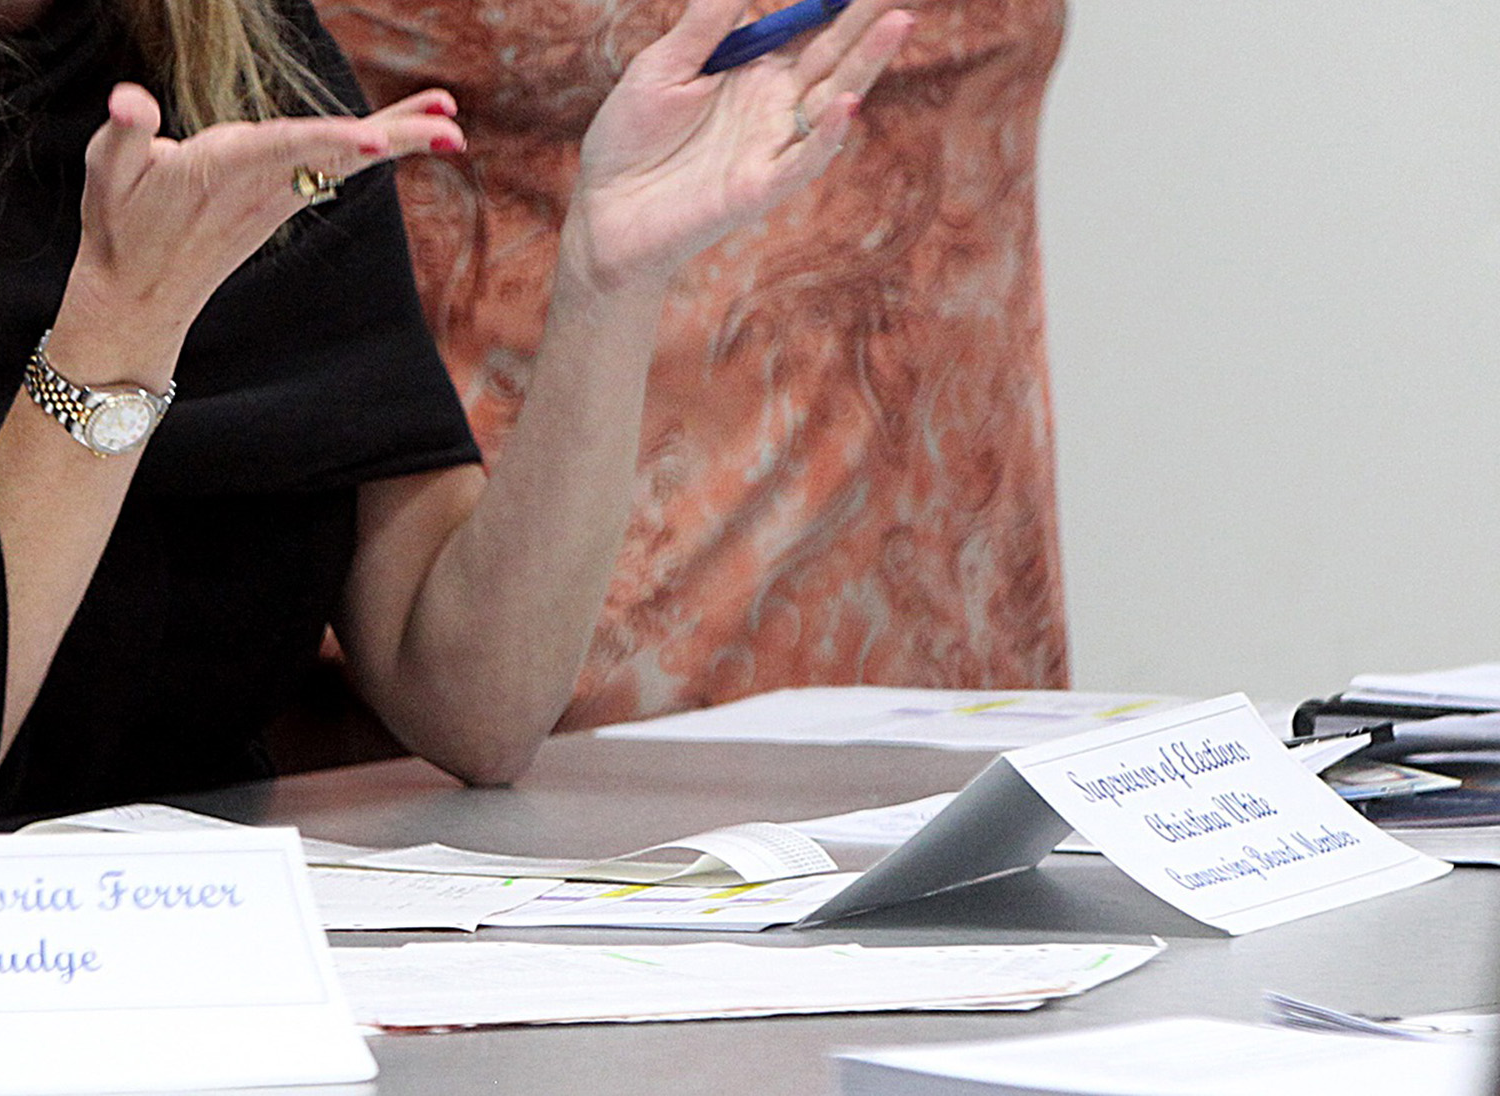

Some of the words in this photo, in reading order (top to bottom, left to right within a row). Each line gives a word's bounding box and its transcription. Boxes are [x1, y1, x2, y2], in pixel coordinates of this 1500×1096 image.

[1158, 746, 1192, 789] of
[1171, 738, 1251, 776] Elections
[1066, 762, 1165, 808] Supervisor
[1143, 807, 1232, 843] Christina
[1211, 791, 1278, 824] White
[1164, 856, 1267, 891] Canvassing
[1242, 836, 1305, 870] Board
[1289, 823, 1361, 857] Member
[99, 869, 245, 911] Ferrer
